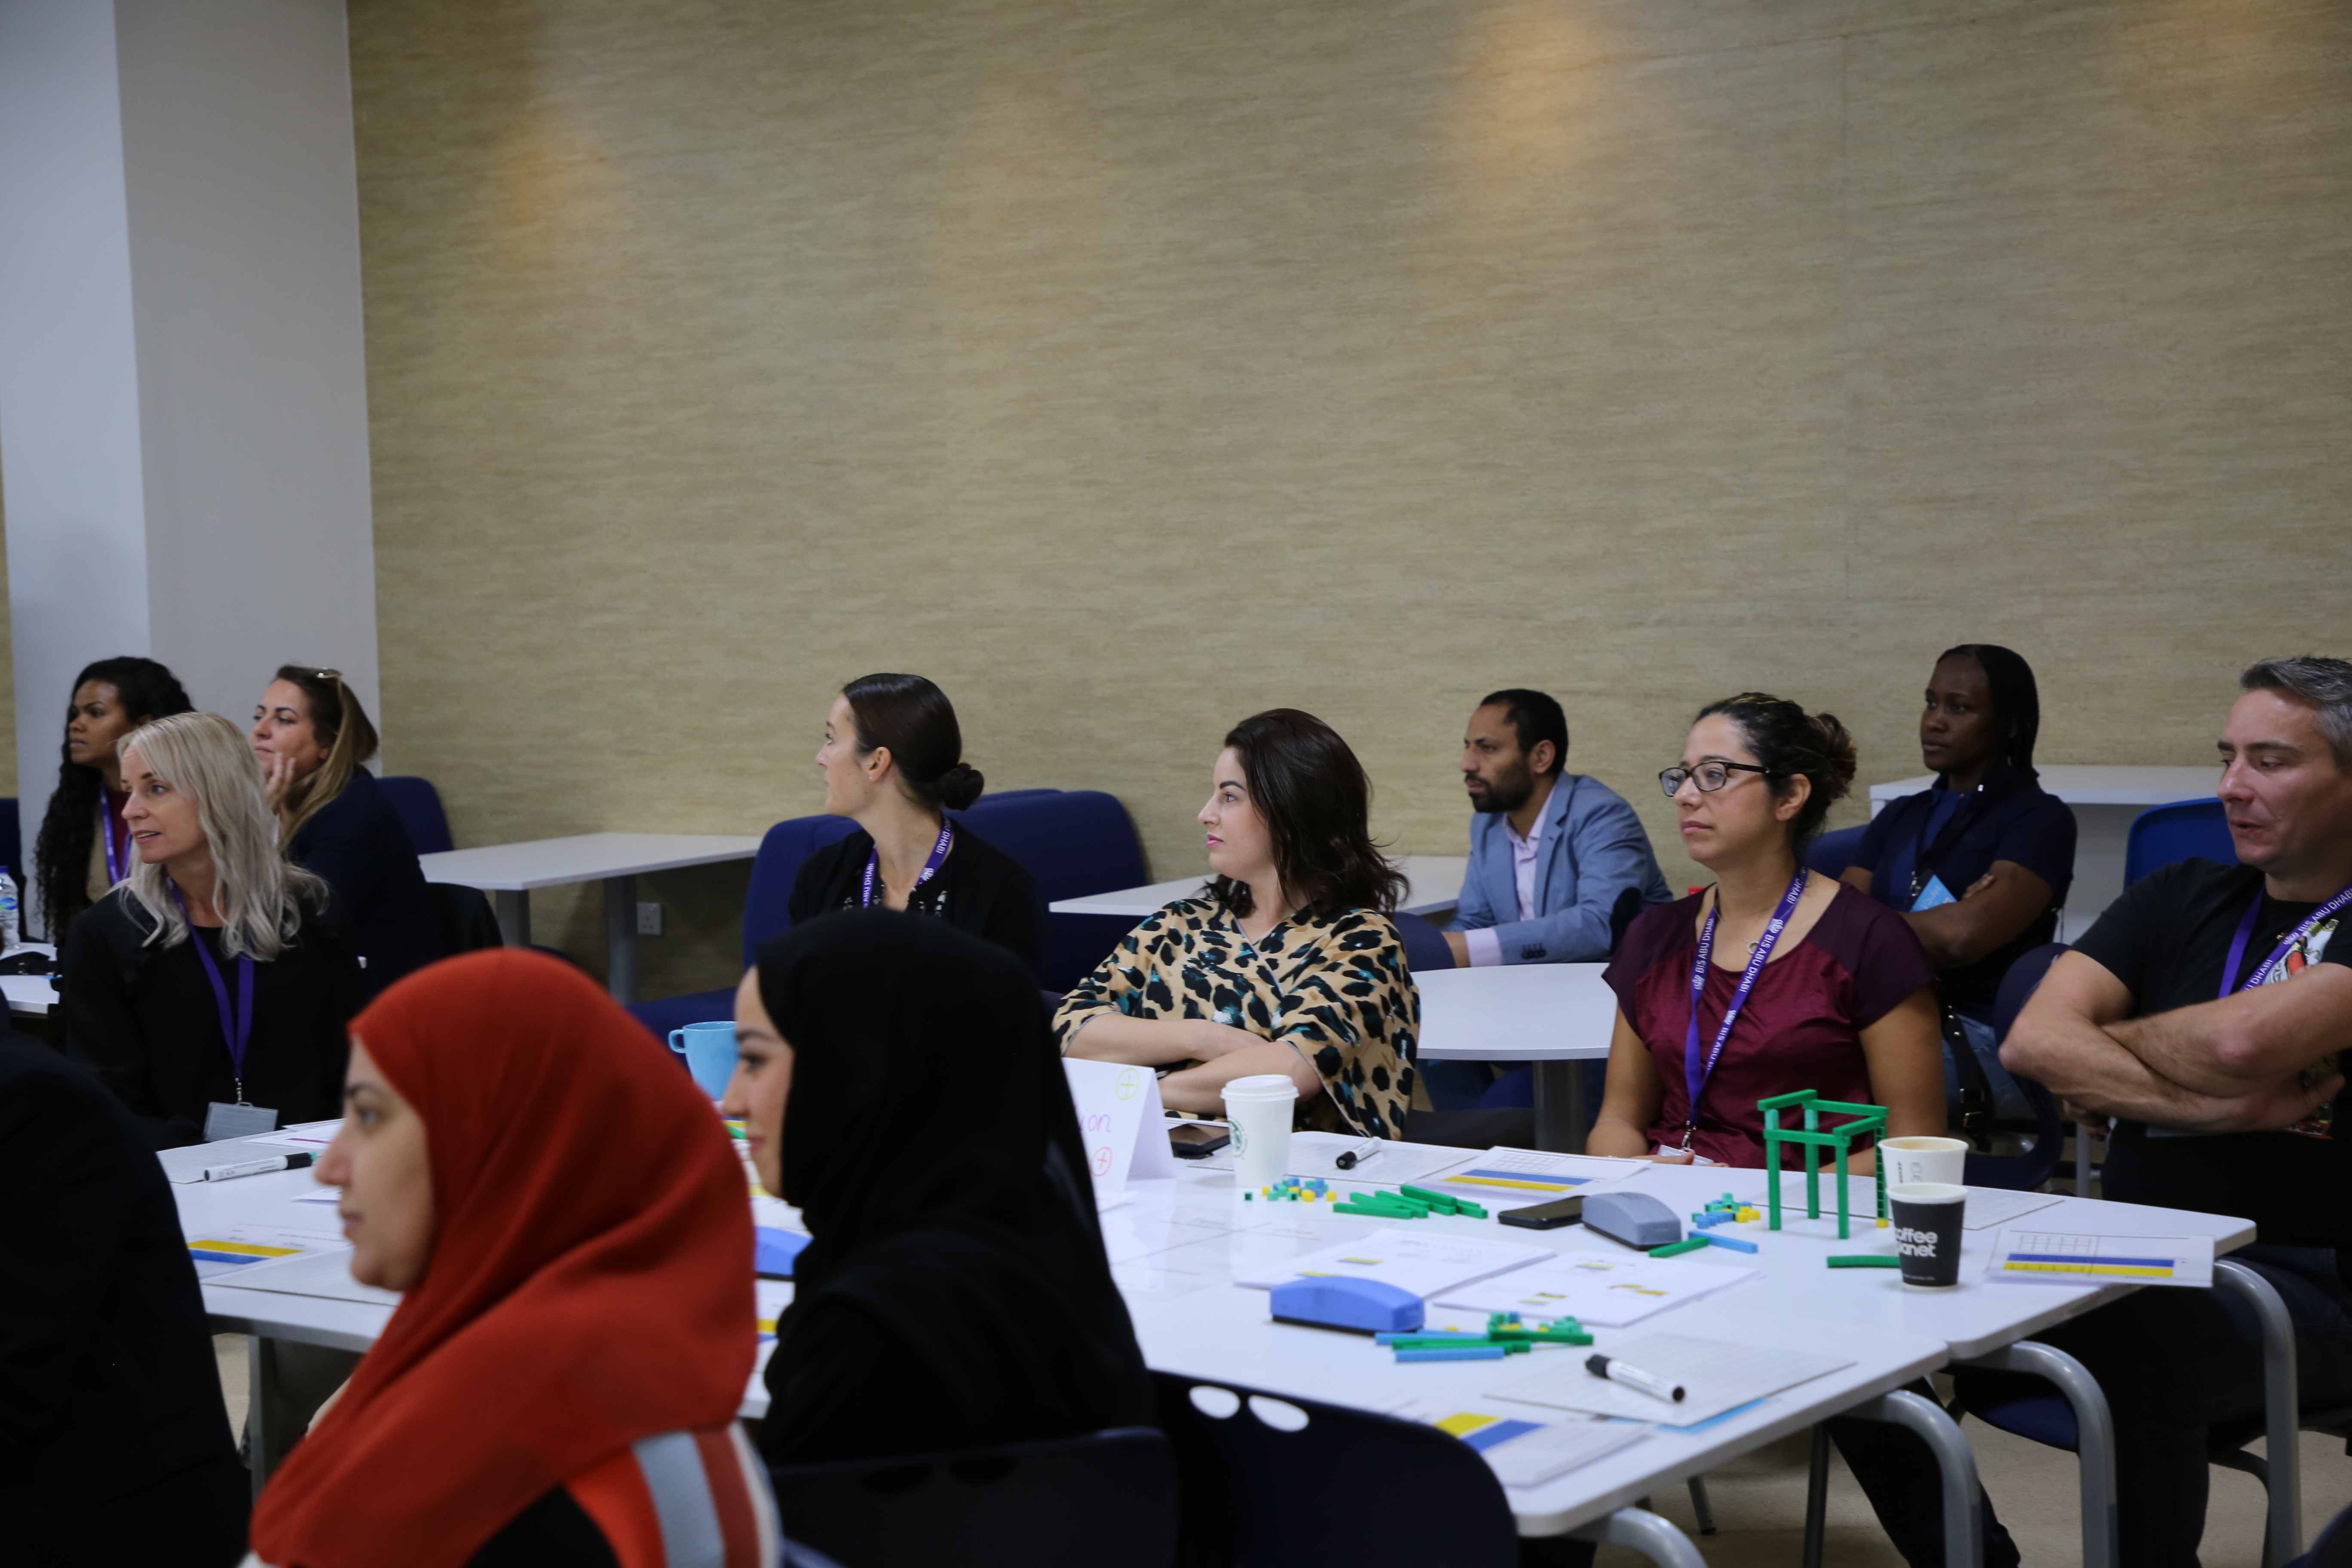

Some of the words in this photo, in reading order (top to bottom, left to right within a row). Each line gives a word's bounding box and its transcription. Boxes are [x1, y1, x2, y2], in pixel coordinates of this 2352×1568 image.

[935, 831, 950, 854] DHABI
[864, 863, 875, 885] DHABI
[2312, 906, 2331, 922] ABU
[1697, 943, 1710, 959] ABU
[1761, 934, 1775, 948] BIS
[1752, 947, 1767, 966] ABU
[1695, 960, 1706, 974] BIS
[2250, 959, 2274, 984] DHABI
[1739, 966, 1758, 993] DHABI
[1079, 1109, 1112, 1133] ion
